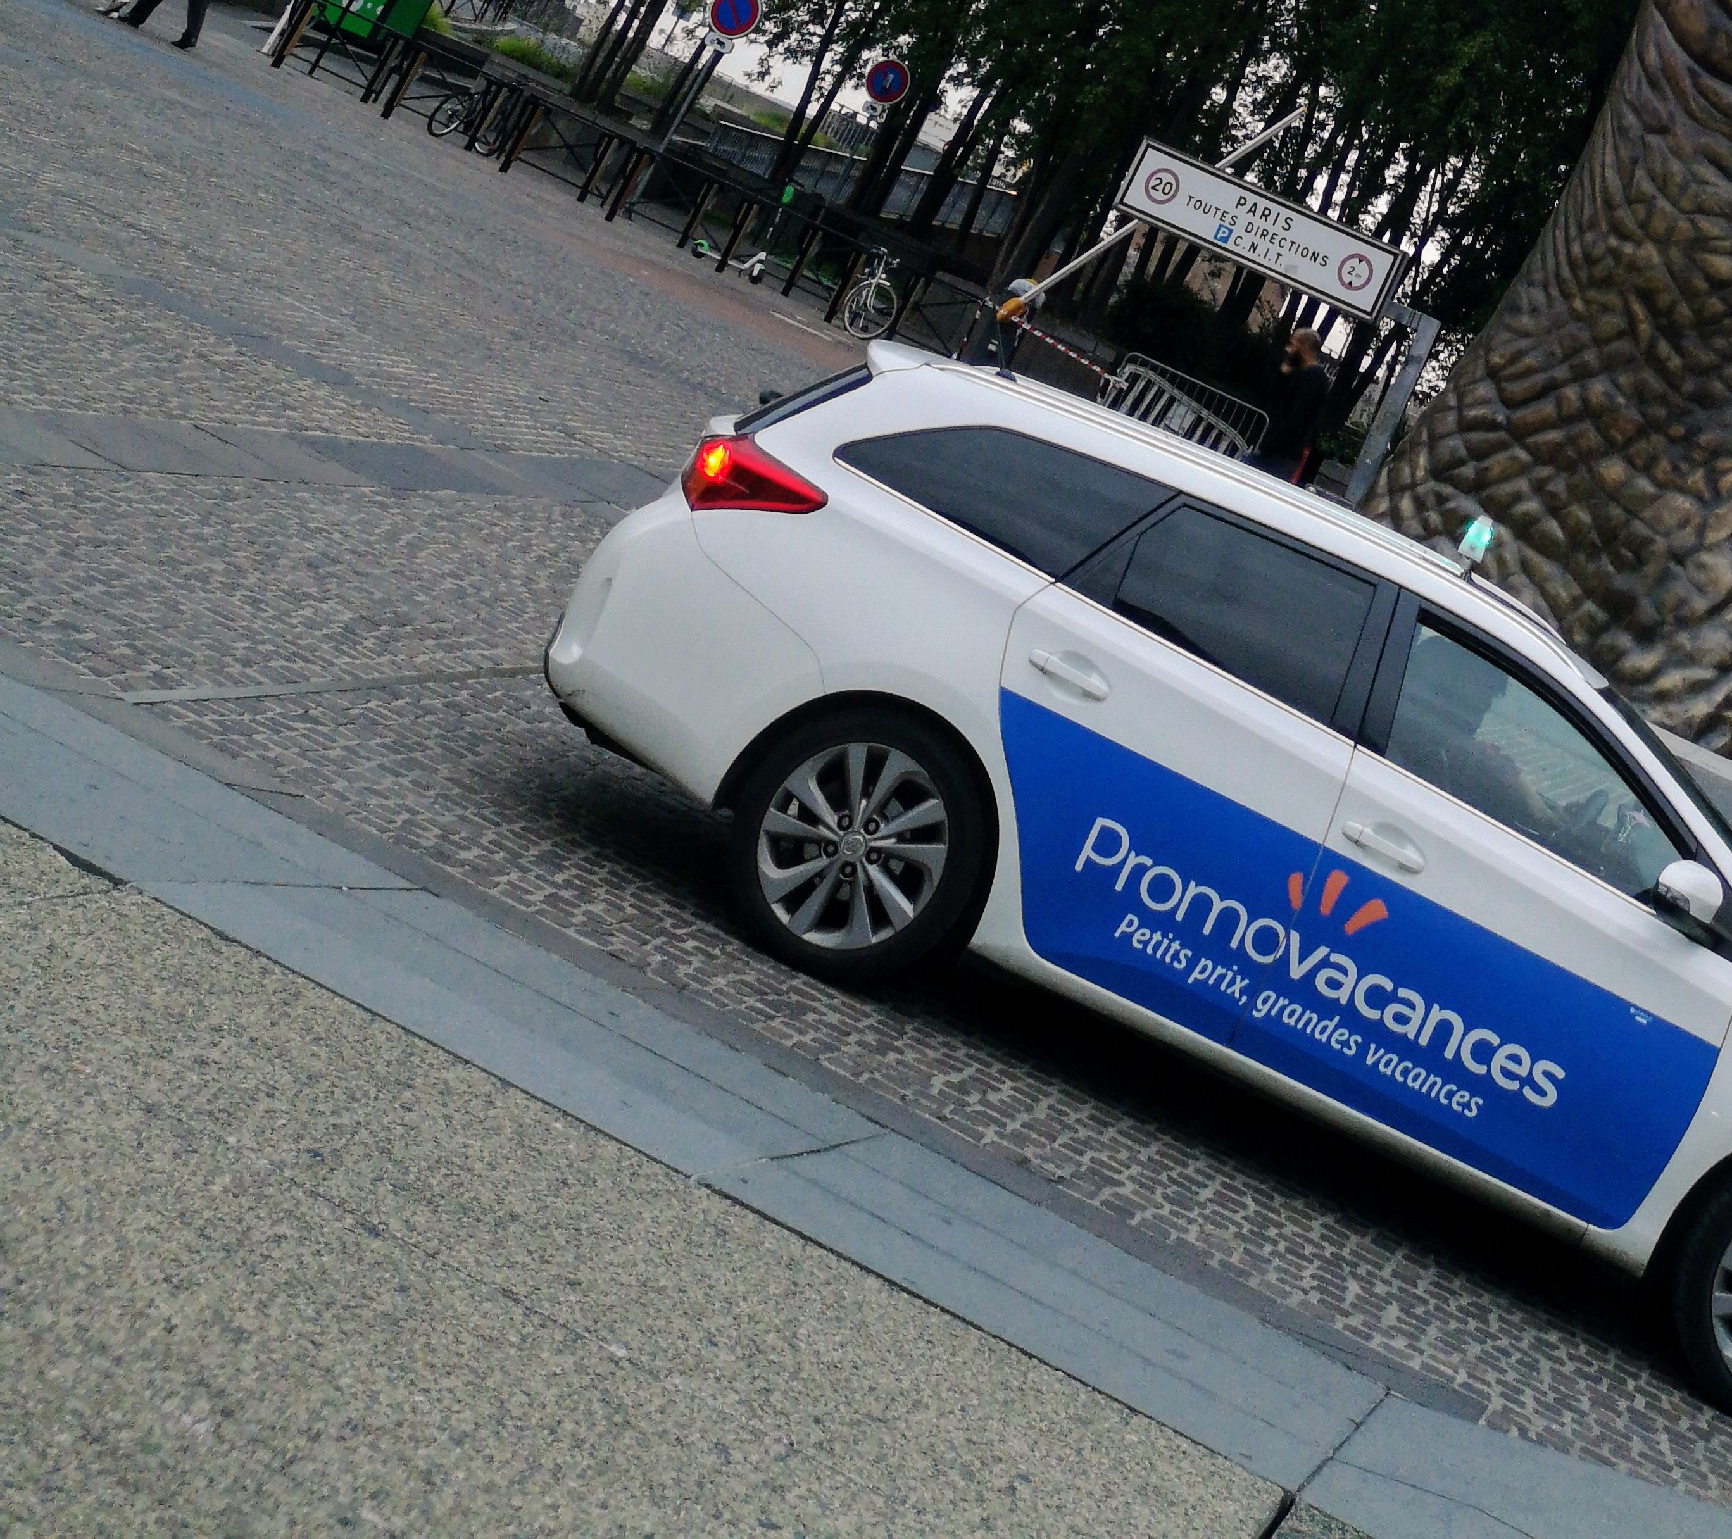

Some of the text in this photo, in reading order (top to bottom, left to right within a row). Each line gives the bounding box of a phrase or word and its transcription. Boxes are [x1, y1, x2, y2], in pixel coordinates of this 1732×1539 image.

[1150, 177, 1173, 196] 20
[1235, 195, 1293, 232] PARIS
[1186, 194, 1329, 268] TOUTES DIRECTIONS
[1233, 235, 1283, 267] C.N.I.T.
[1074, 817, 1567, 1109] Promovacances
[1113, 913, 1484, 1118] Petits prix, grandes vacances
